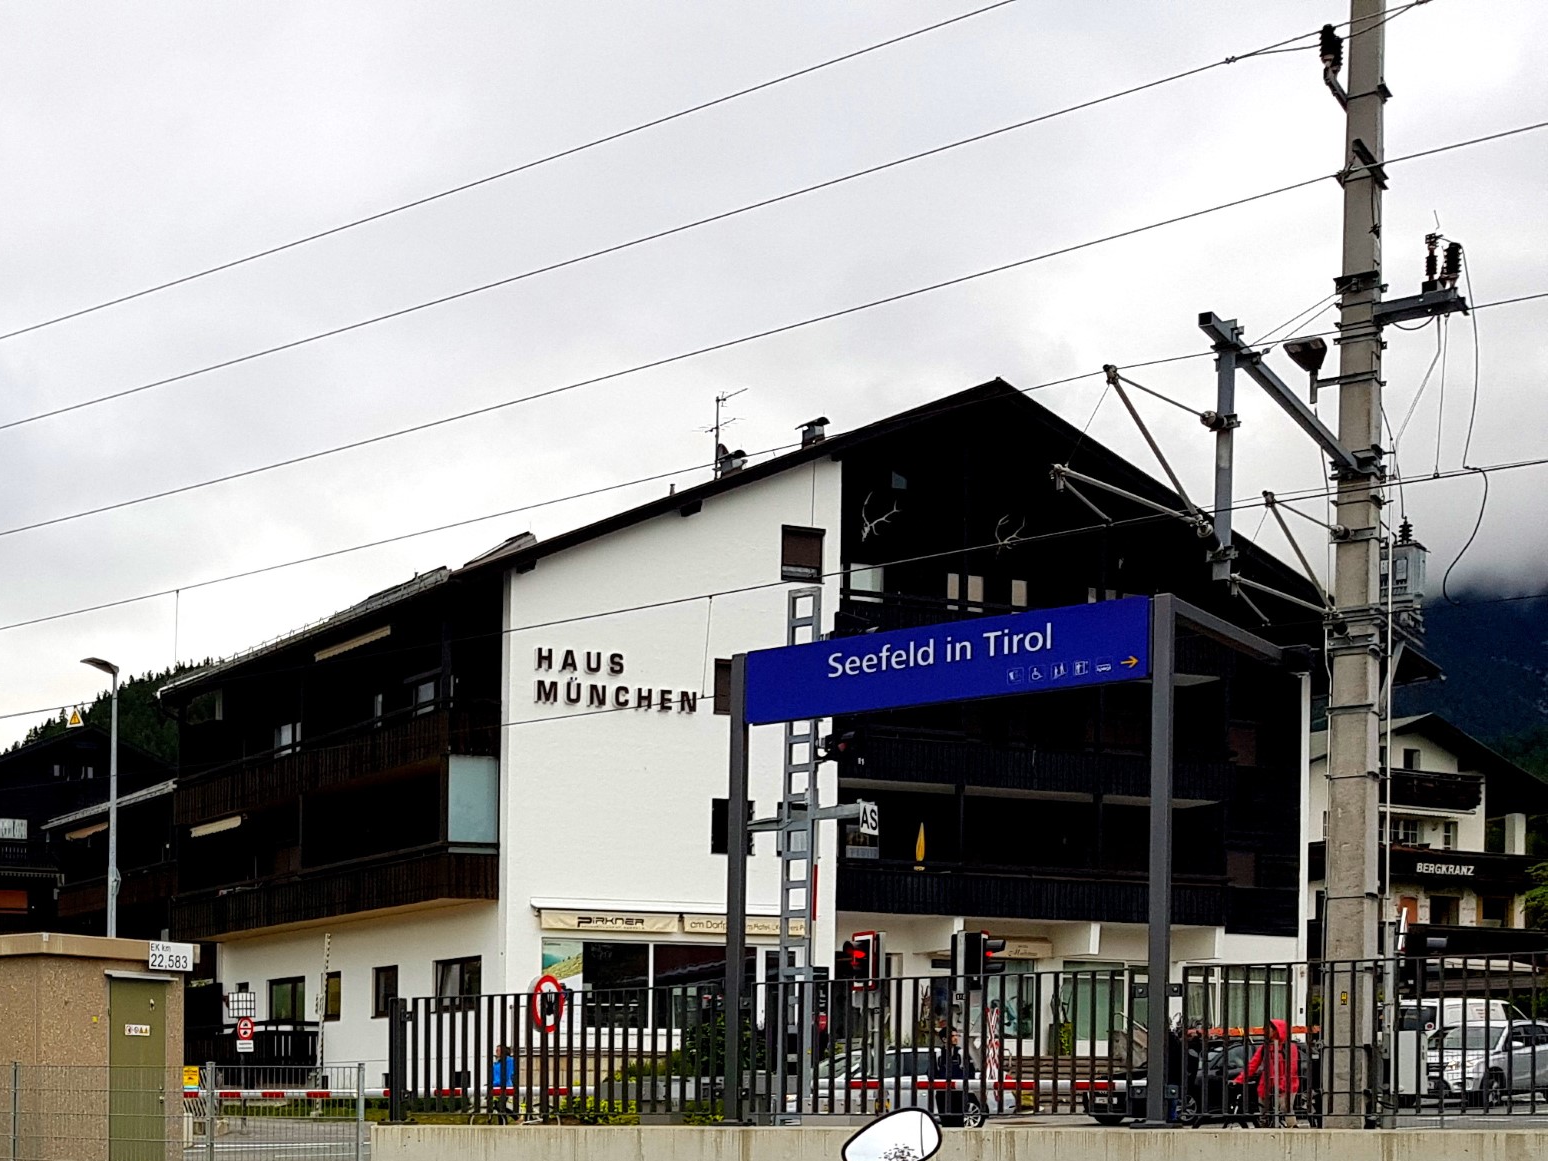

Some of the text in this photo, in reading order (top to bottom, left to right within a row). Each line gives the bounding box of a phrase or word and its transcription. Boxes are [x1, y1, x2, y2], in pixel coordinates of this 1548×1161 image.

[534, 646, 625, 677] HAUS
[827, 622, 1052, 678] Seefeld in Tirol
[534, 676, 698, 714] MÜNCHEN
[860, 805, 878, 831] AS
[1416, 862, 1475, 876] BERGKRANZ
[150, 943, 161, 951] EK
[150, 953, 188, 969] 22,583
